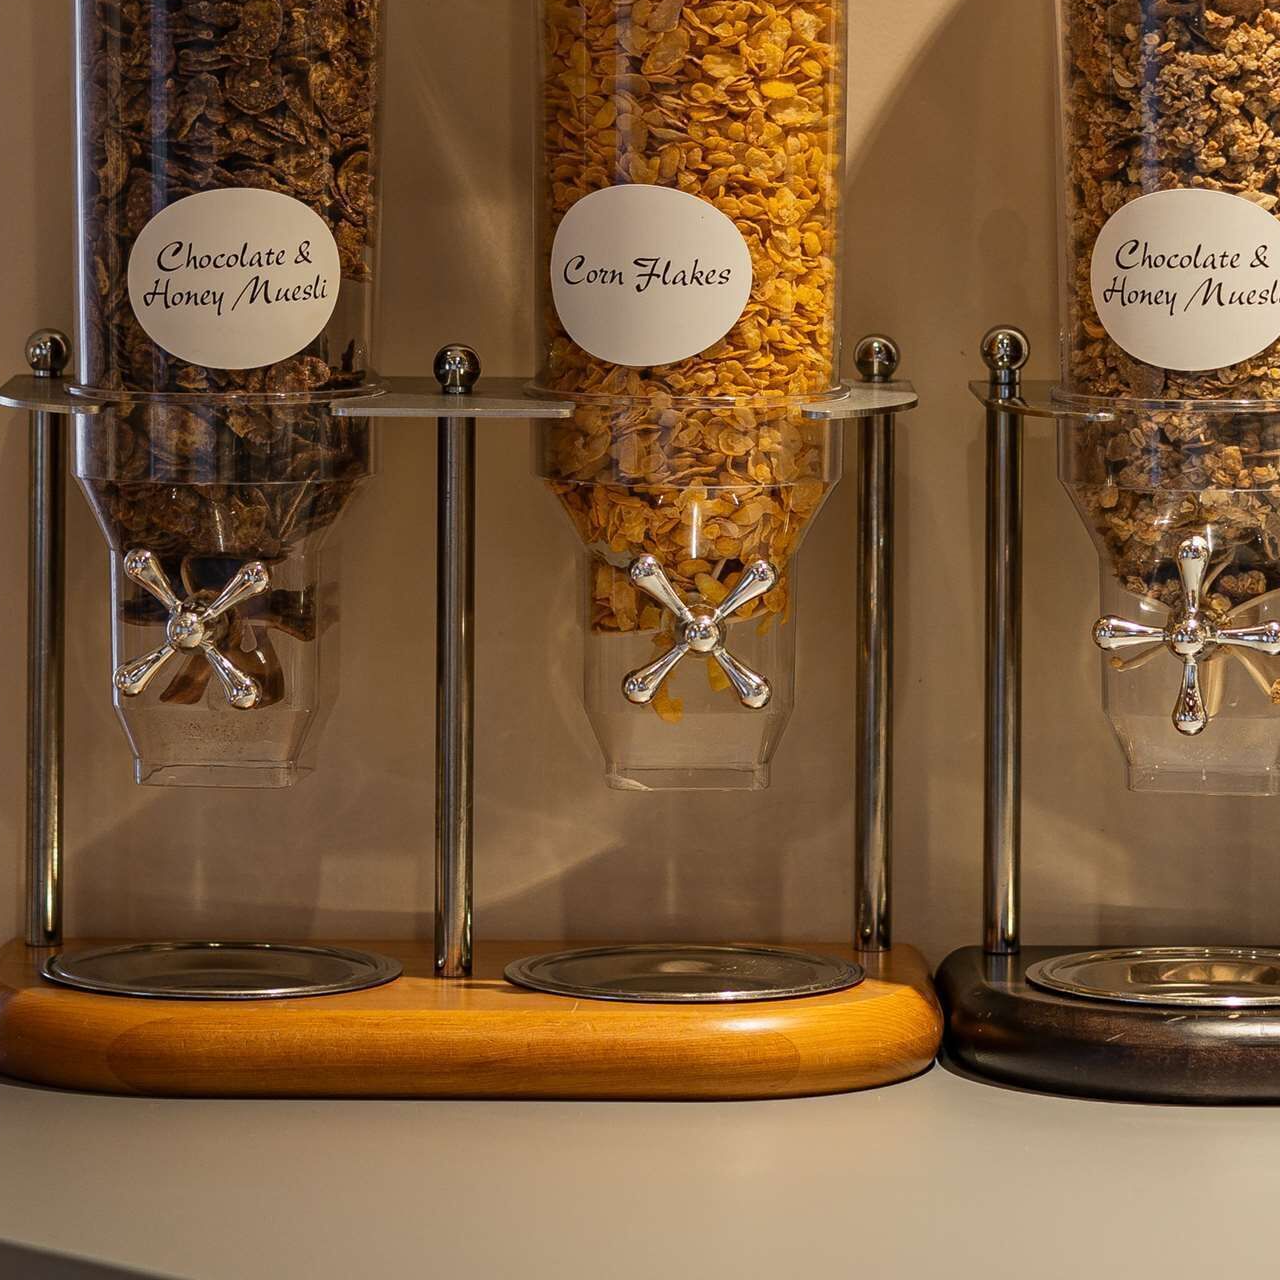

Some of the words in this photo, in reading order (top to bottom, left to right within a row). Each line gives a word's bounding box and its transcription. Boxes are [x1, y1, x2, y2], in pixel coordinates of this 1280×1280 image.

[156, 240, 286, 272] Chocolate
[293, 240, 313, 265] &
[563, 254, 625, 286] Corn
[632, 256, 732, 293] Flakes
[1115, 239, 1241, 270] Chocolate
[1249, 244, 1270, 269] &
[142, 277, 225, 317] Honey
[231, 274, 328, 312] Muesli
[1103, 275, 1178, 317] Honey
